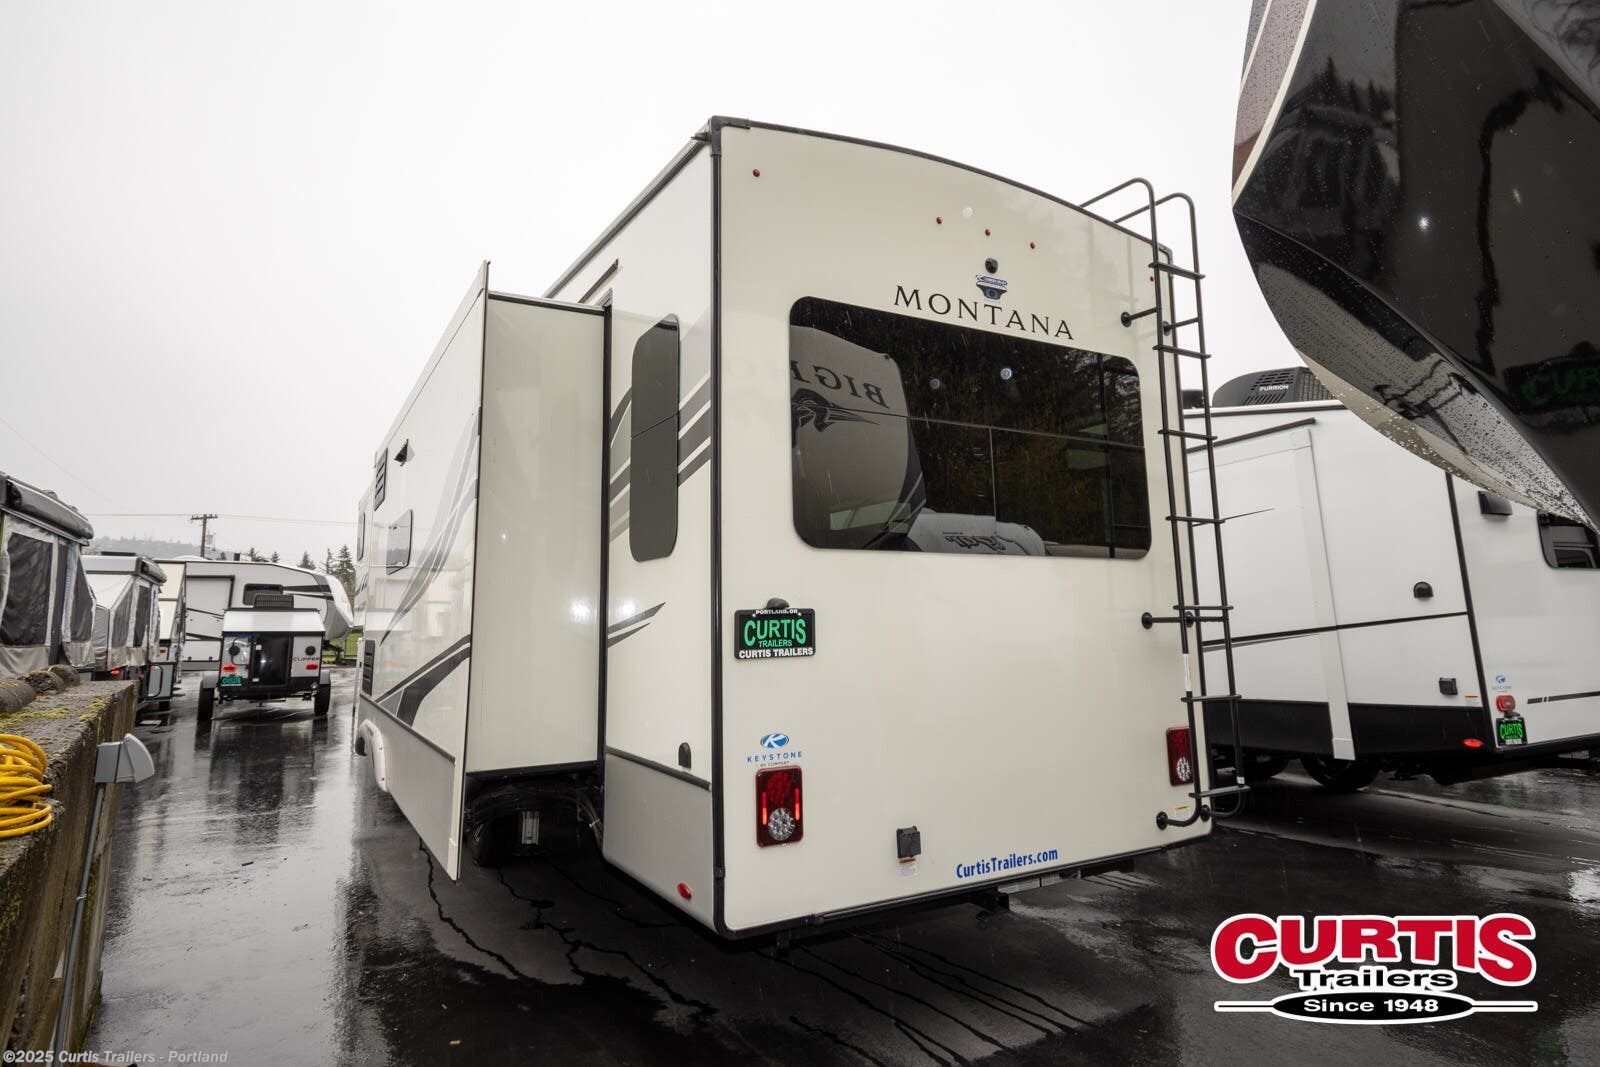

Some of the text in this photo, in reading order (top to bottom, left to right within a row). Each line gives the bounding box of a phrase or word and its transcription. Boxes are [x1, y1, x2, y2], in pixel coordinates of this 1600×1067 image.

[894, 285, 1074, 340] MONTANA
[744, 619, 806, 646] CURTIS
[739, 647, 814, 658] CURTIS TRAILERS
[1500, 723, 1523, 738] CURTIS
[747, 751, 803, 763] KEYSTONE
[957, 849, 1058, 878] CurtisTrailers.com
